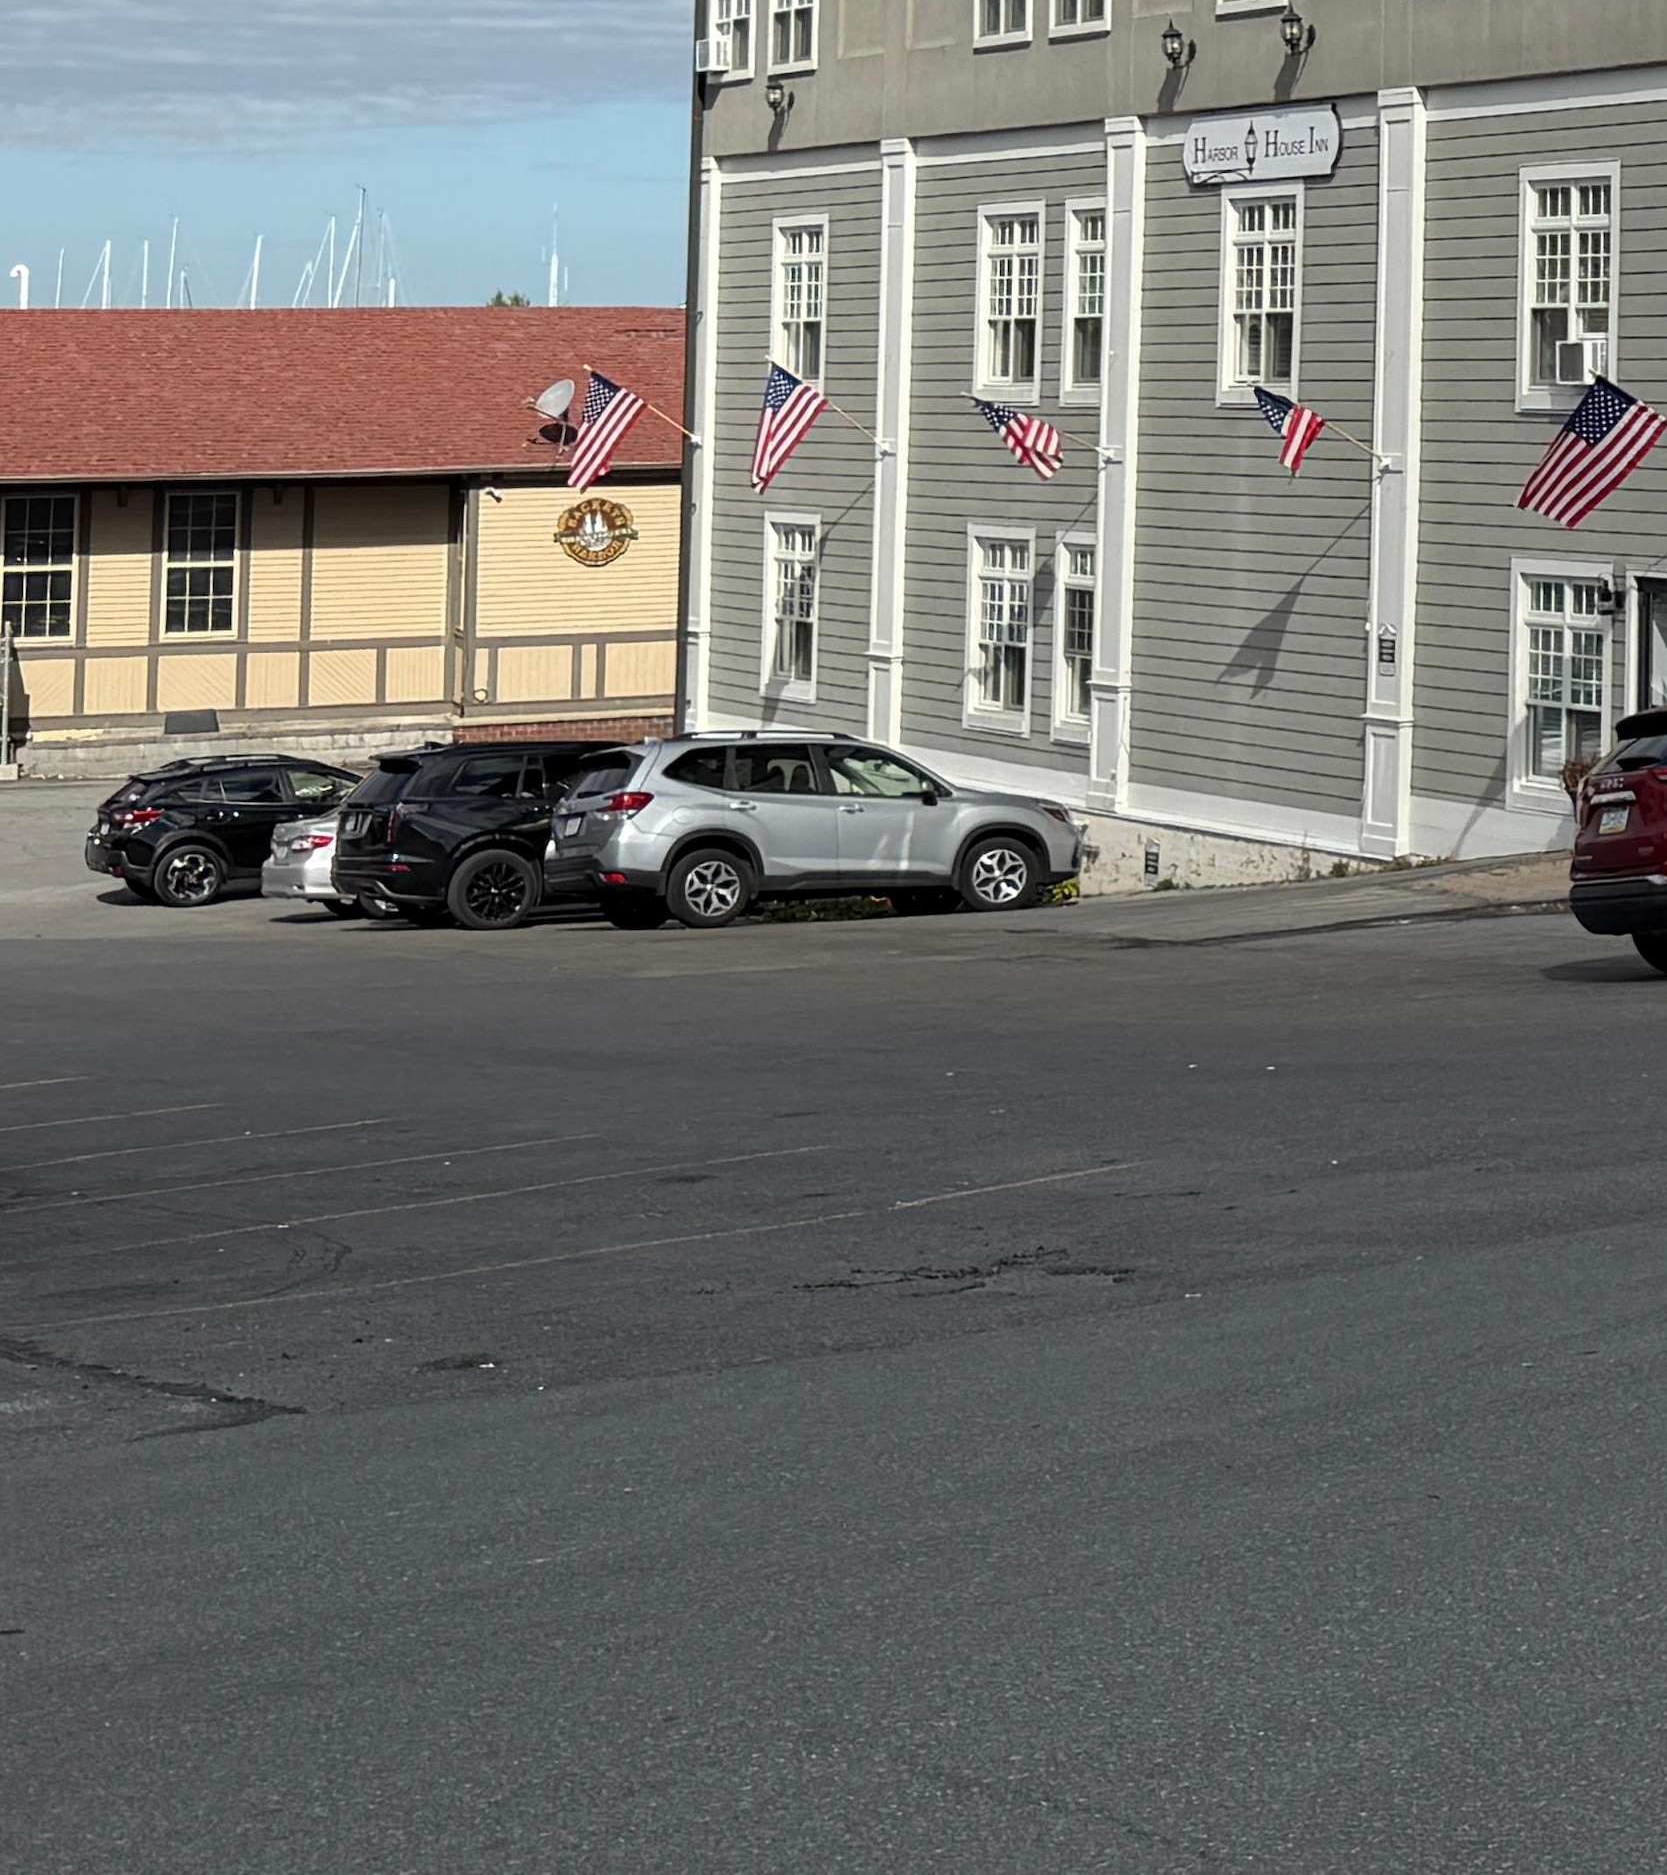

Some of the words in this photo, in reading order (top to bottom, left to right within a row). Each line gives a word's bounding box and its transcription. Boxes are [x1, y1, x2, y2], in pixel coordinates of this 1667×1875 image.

[1193, 137, 1239, 164] HARBOR
[1264, 129, 1305, 158] HOUSE
[1308, 126, 1329, 154] INN
